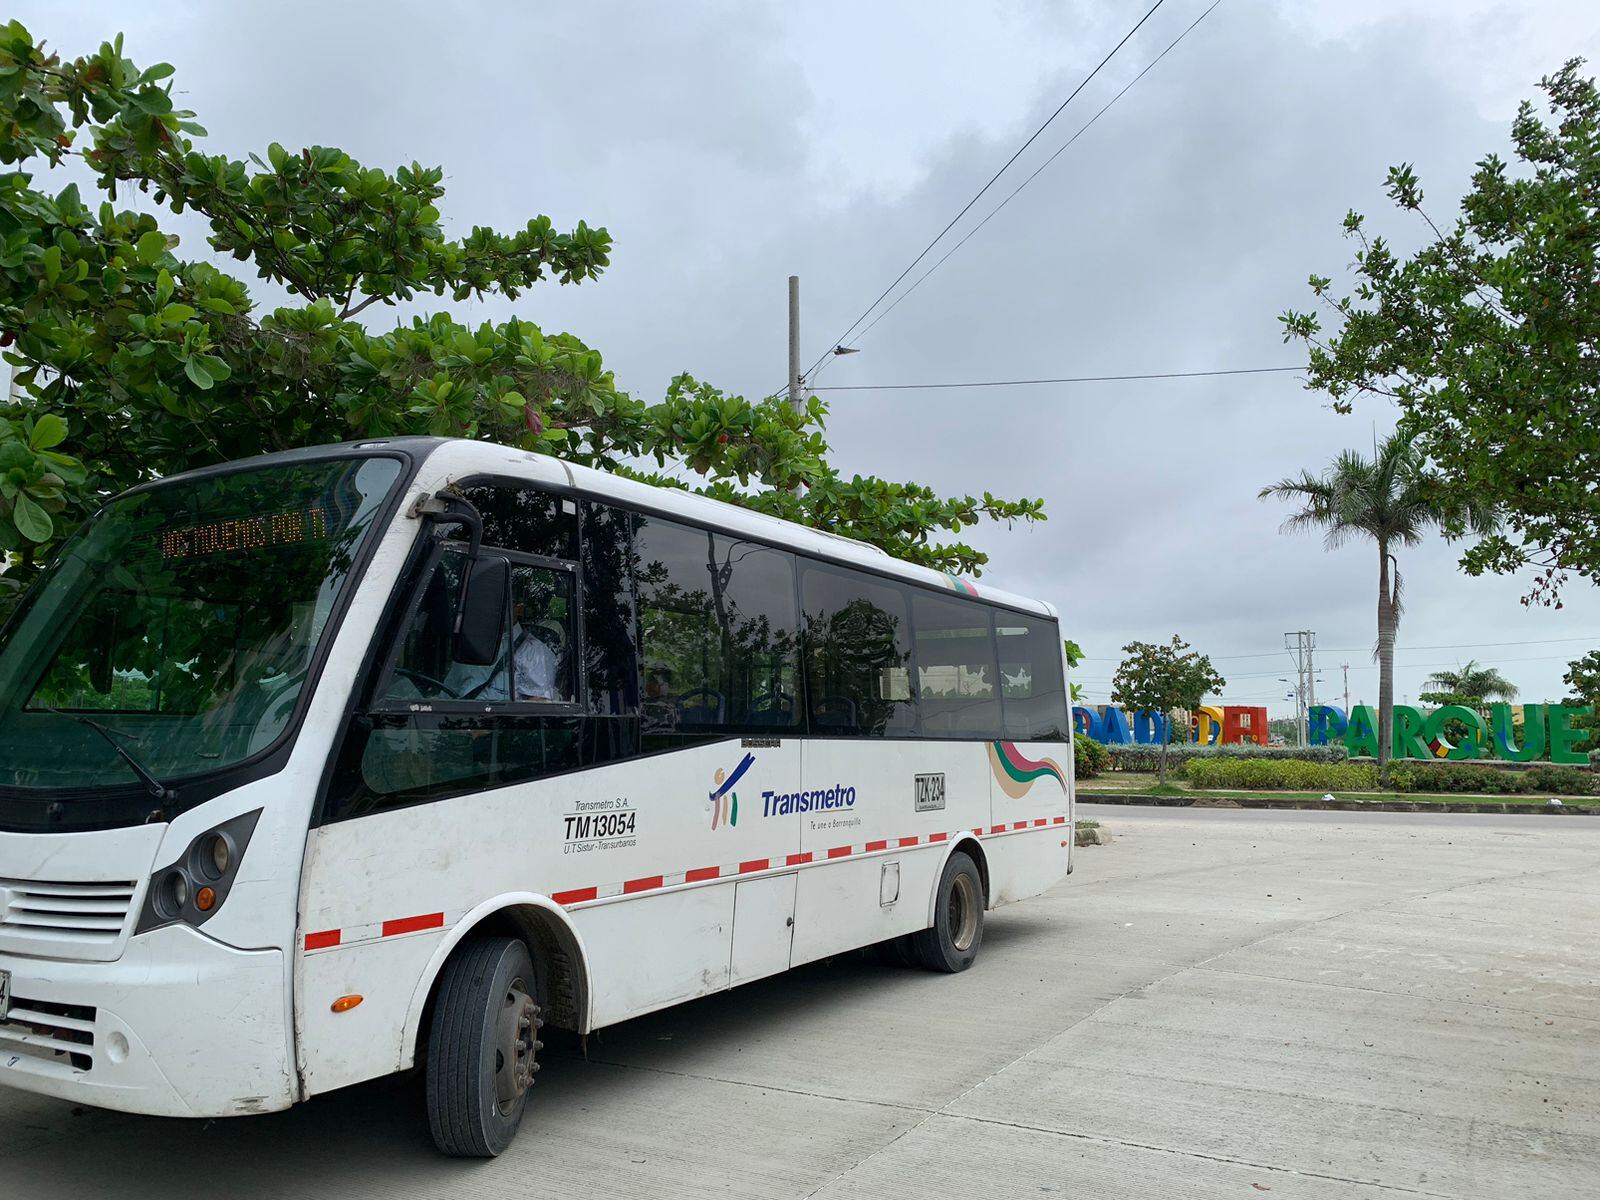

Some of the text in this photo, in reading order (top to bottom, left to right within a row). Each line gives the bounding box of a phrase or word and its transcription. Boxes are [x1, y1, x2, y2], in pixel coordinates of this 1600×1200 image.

[272, 512, 302, 544] POR
[308, 508, 325, 538] TI
[1309, 703, 1592, 764] PARQUE
[575, 799, 614, 811] Transmetro
[761, 784, 856, 817] Transmetro
[564, 812, 636, 840] TM13054
[810, 820, 816, 830] Te
[817, 822, 827, 830] une
[832, 817, 861, 829] Barranquilla
